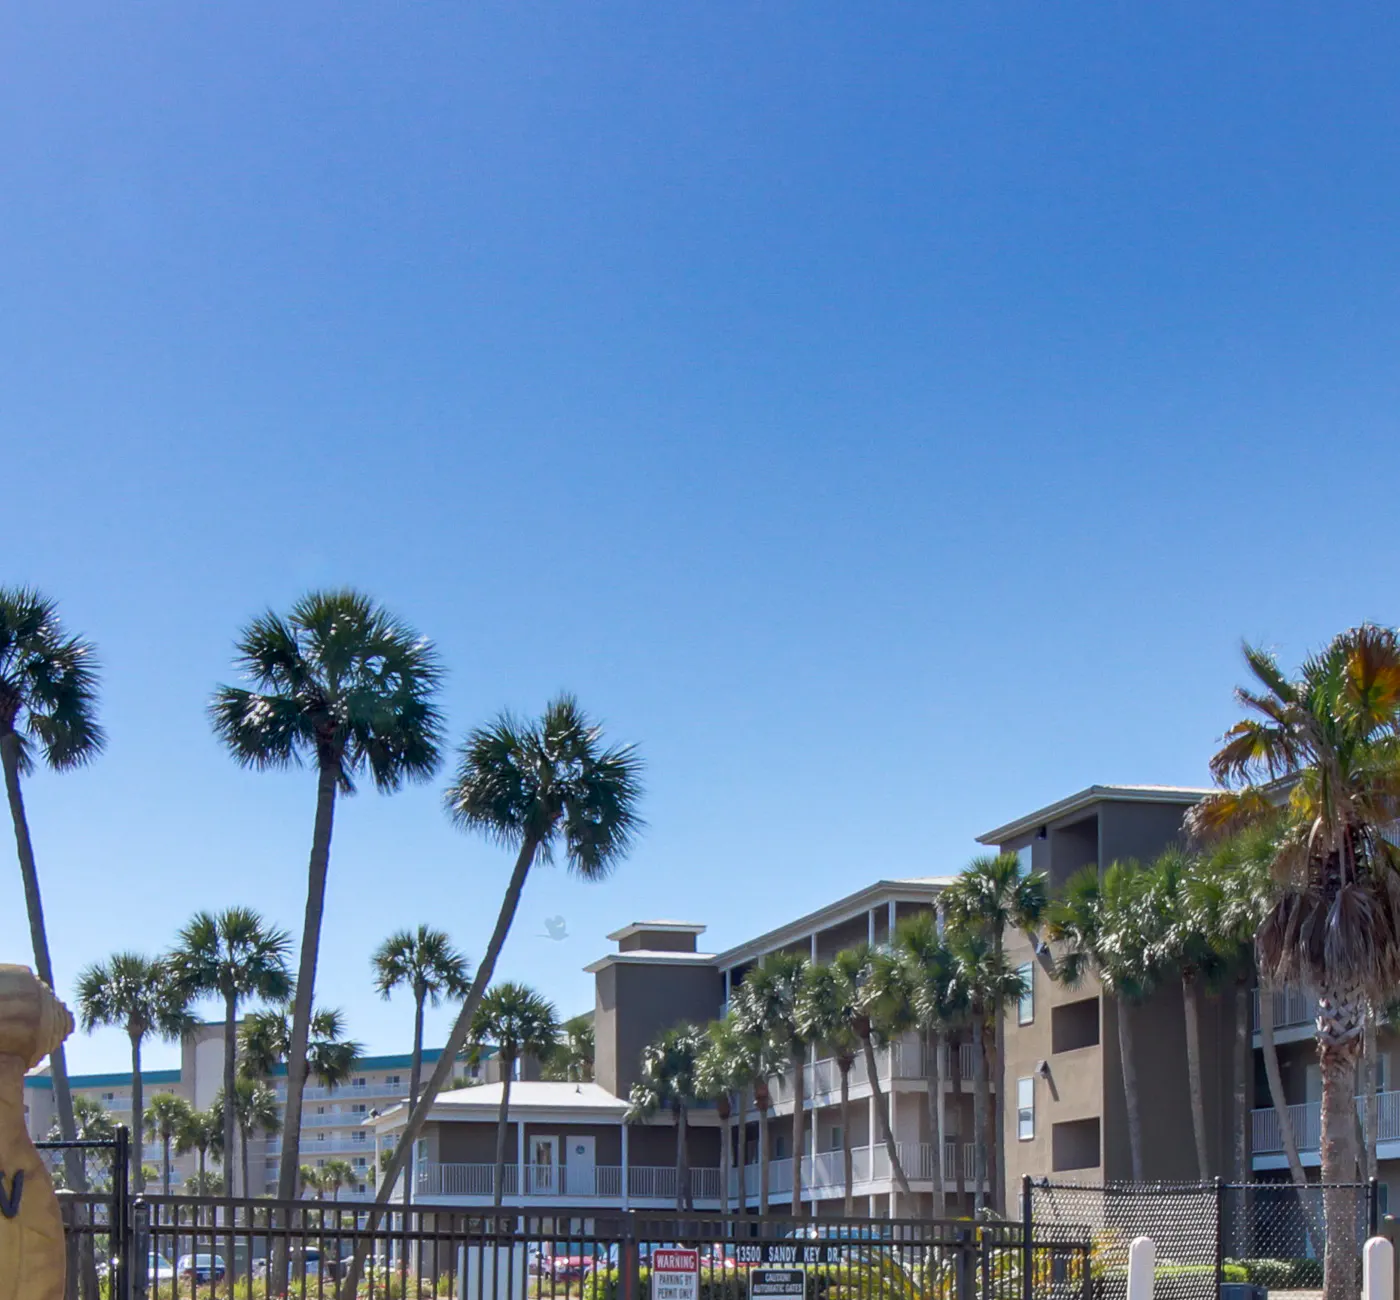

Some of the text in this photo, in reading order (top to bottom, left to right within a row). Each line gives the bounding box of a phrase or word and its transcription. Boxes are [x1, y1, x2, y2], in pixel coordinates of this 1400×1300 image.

[736, 1246, 840, 1262] 13500 SANDY KEY DR.
[657, 1255, 695, 1268] WARNING
[660, 1274, 692, 1285] PARKING BY
[658, 1288, 693, 1300] PERMIT ONLY
[753, 1283, 802, 1293] AUTOMATIC GATES
